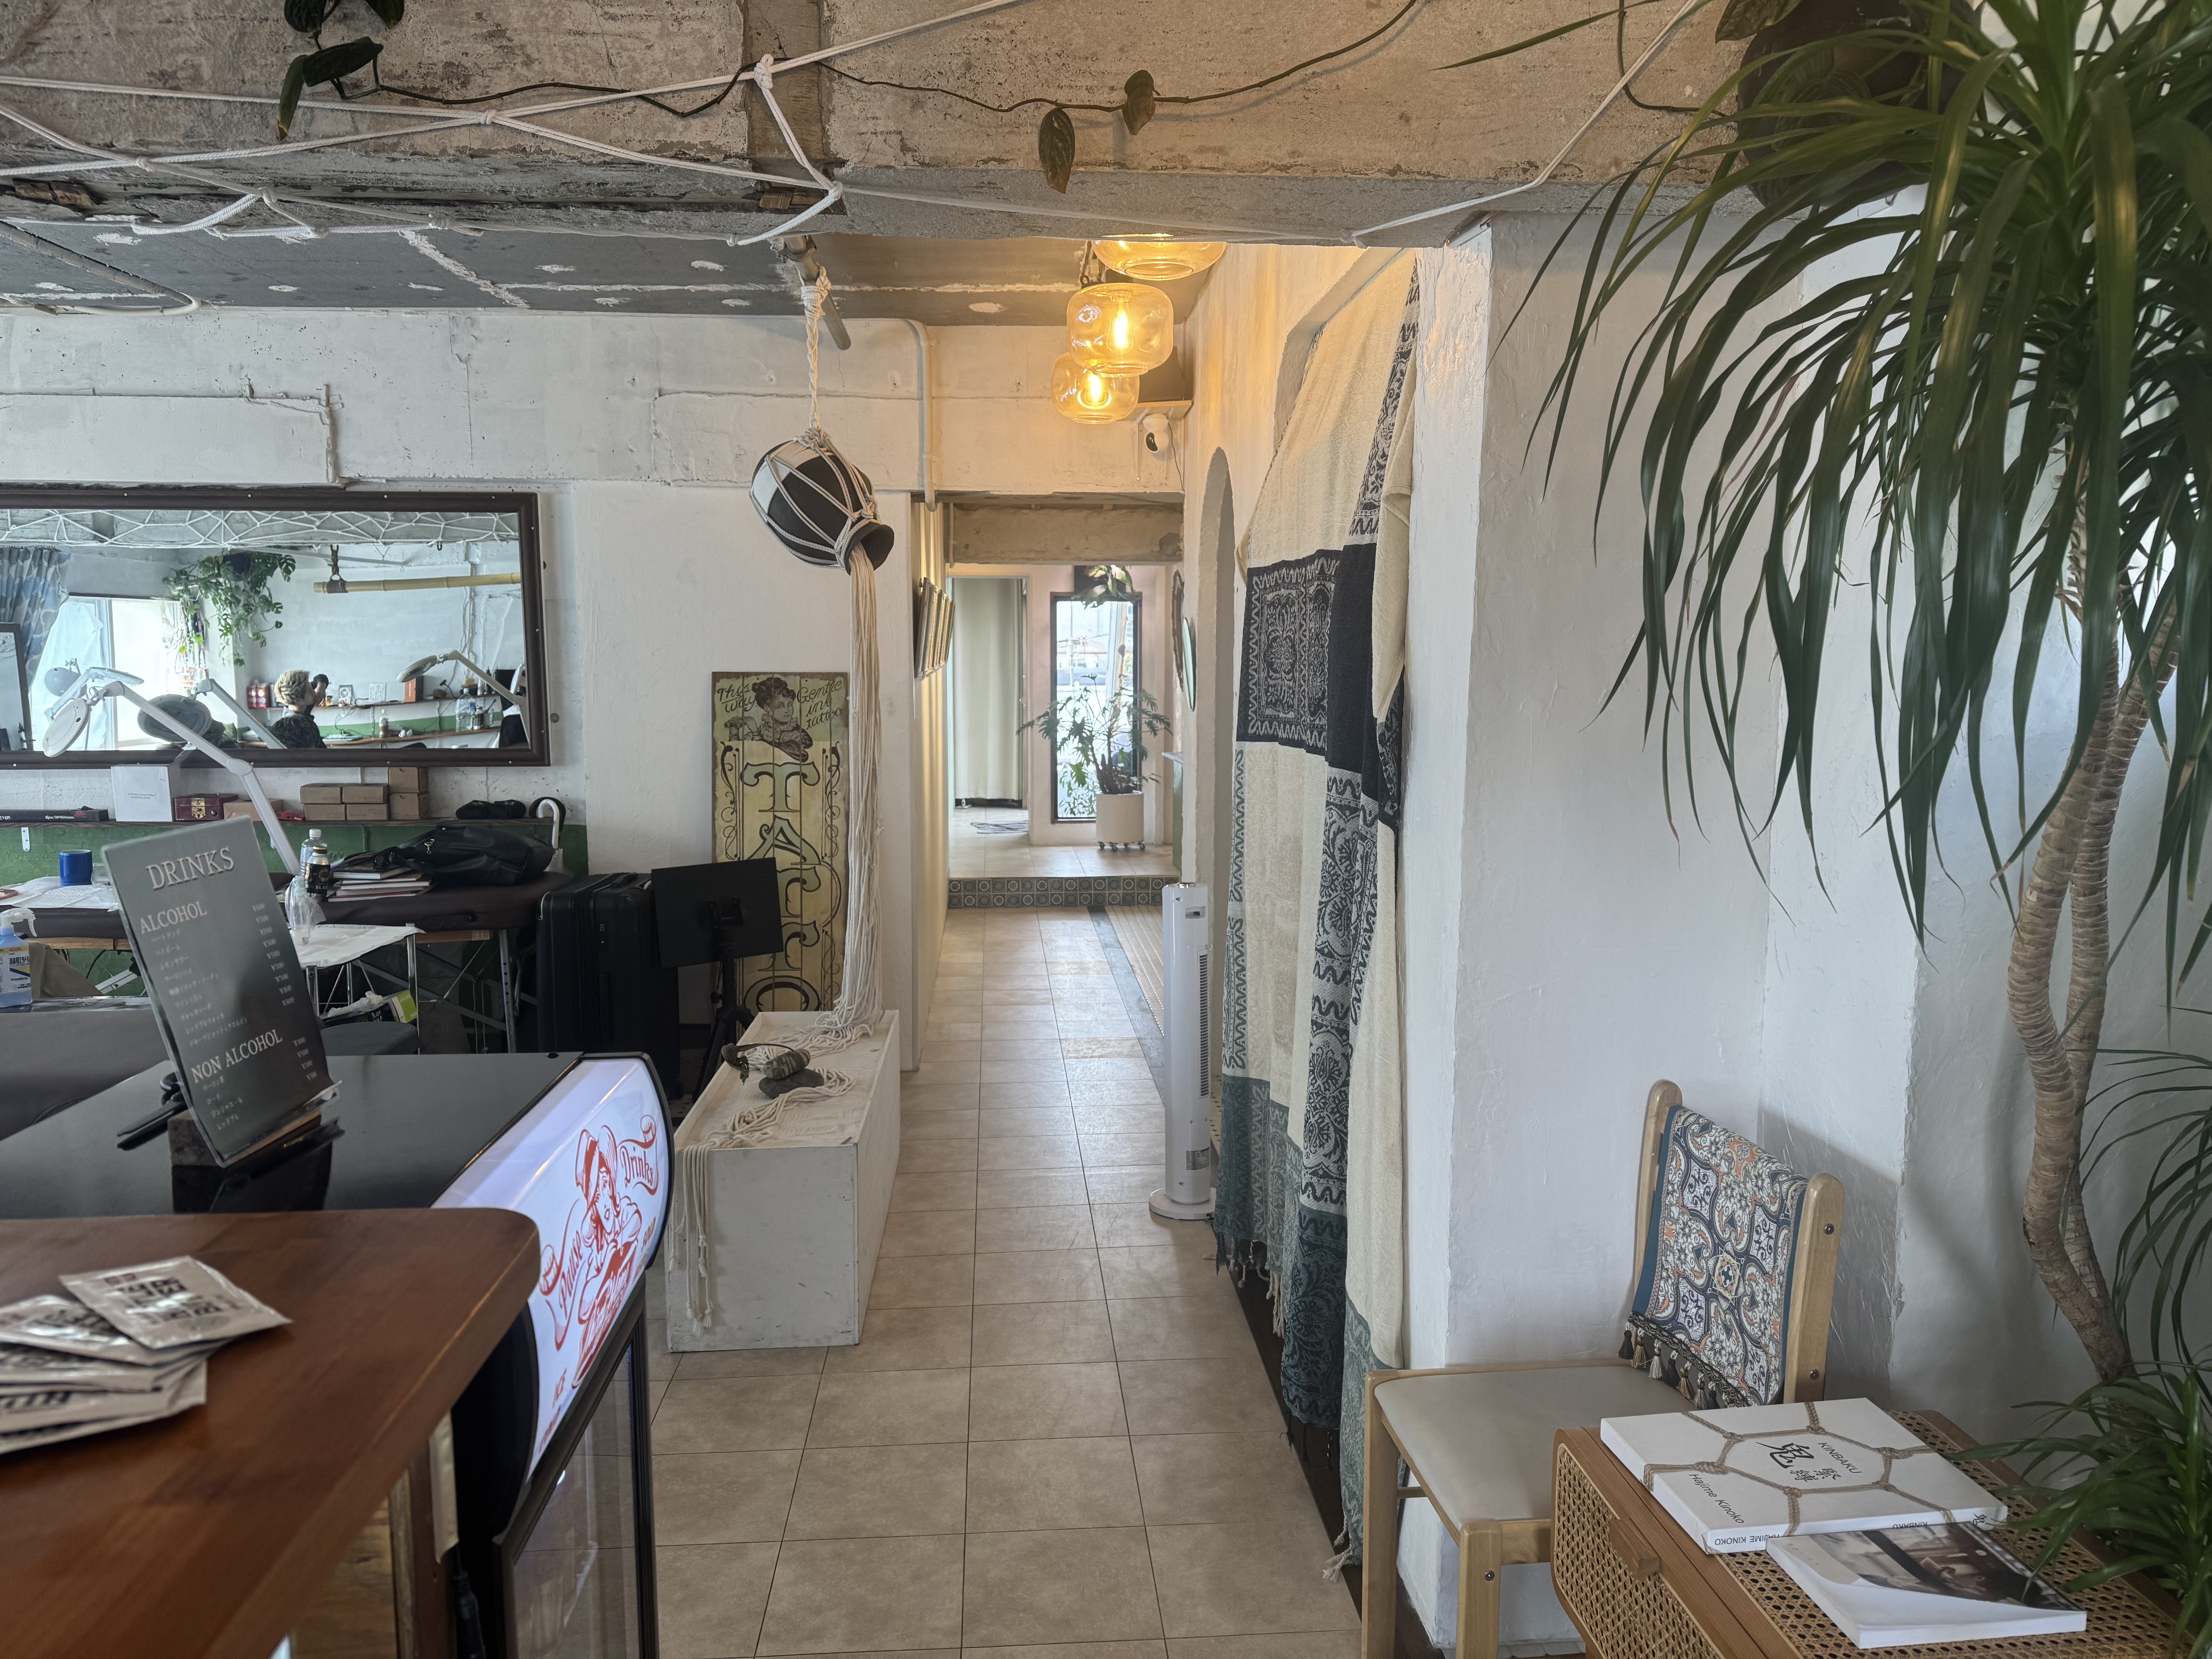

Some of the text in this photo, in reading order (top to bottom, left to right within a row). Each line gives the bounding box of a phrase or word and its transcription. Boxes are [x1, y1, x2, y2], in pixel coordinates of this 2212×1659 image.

[717, 684, 751, 702] This
[797, 680, 843, 704] Gentle
[806, 694, 832, 716] ink
[806, 707, 843, 730] tattoo
[146, 846, 234, 890] DRINKS
[140, 902, 207, 934] ALCOHOL
[191, 1029, 283, 1083] NON ALCOHOL
[620, 1146, 653, 1188] Drinks
[559, 1230, 582, 1320] Pause
[1755, 1442, 1814, 1468] 鬼
[1818, 1443, 1862, 1474] KINBAKU
[1689, 1474, 1744, 1523] Hajime Kinoko
[1715, 1537, 1746, 1545] KINOKO
